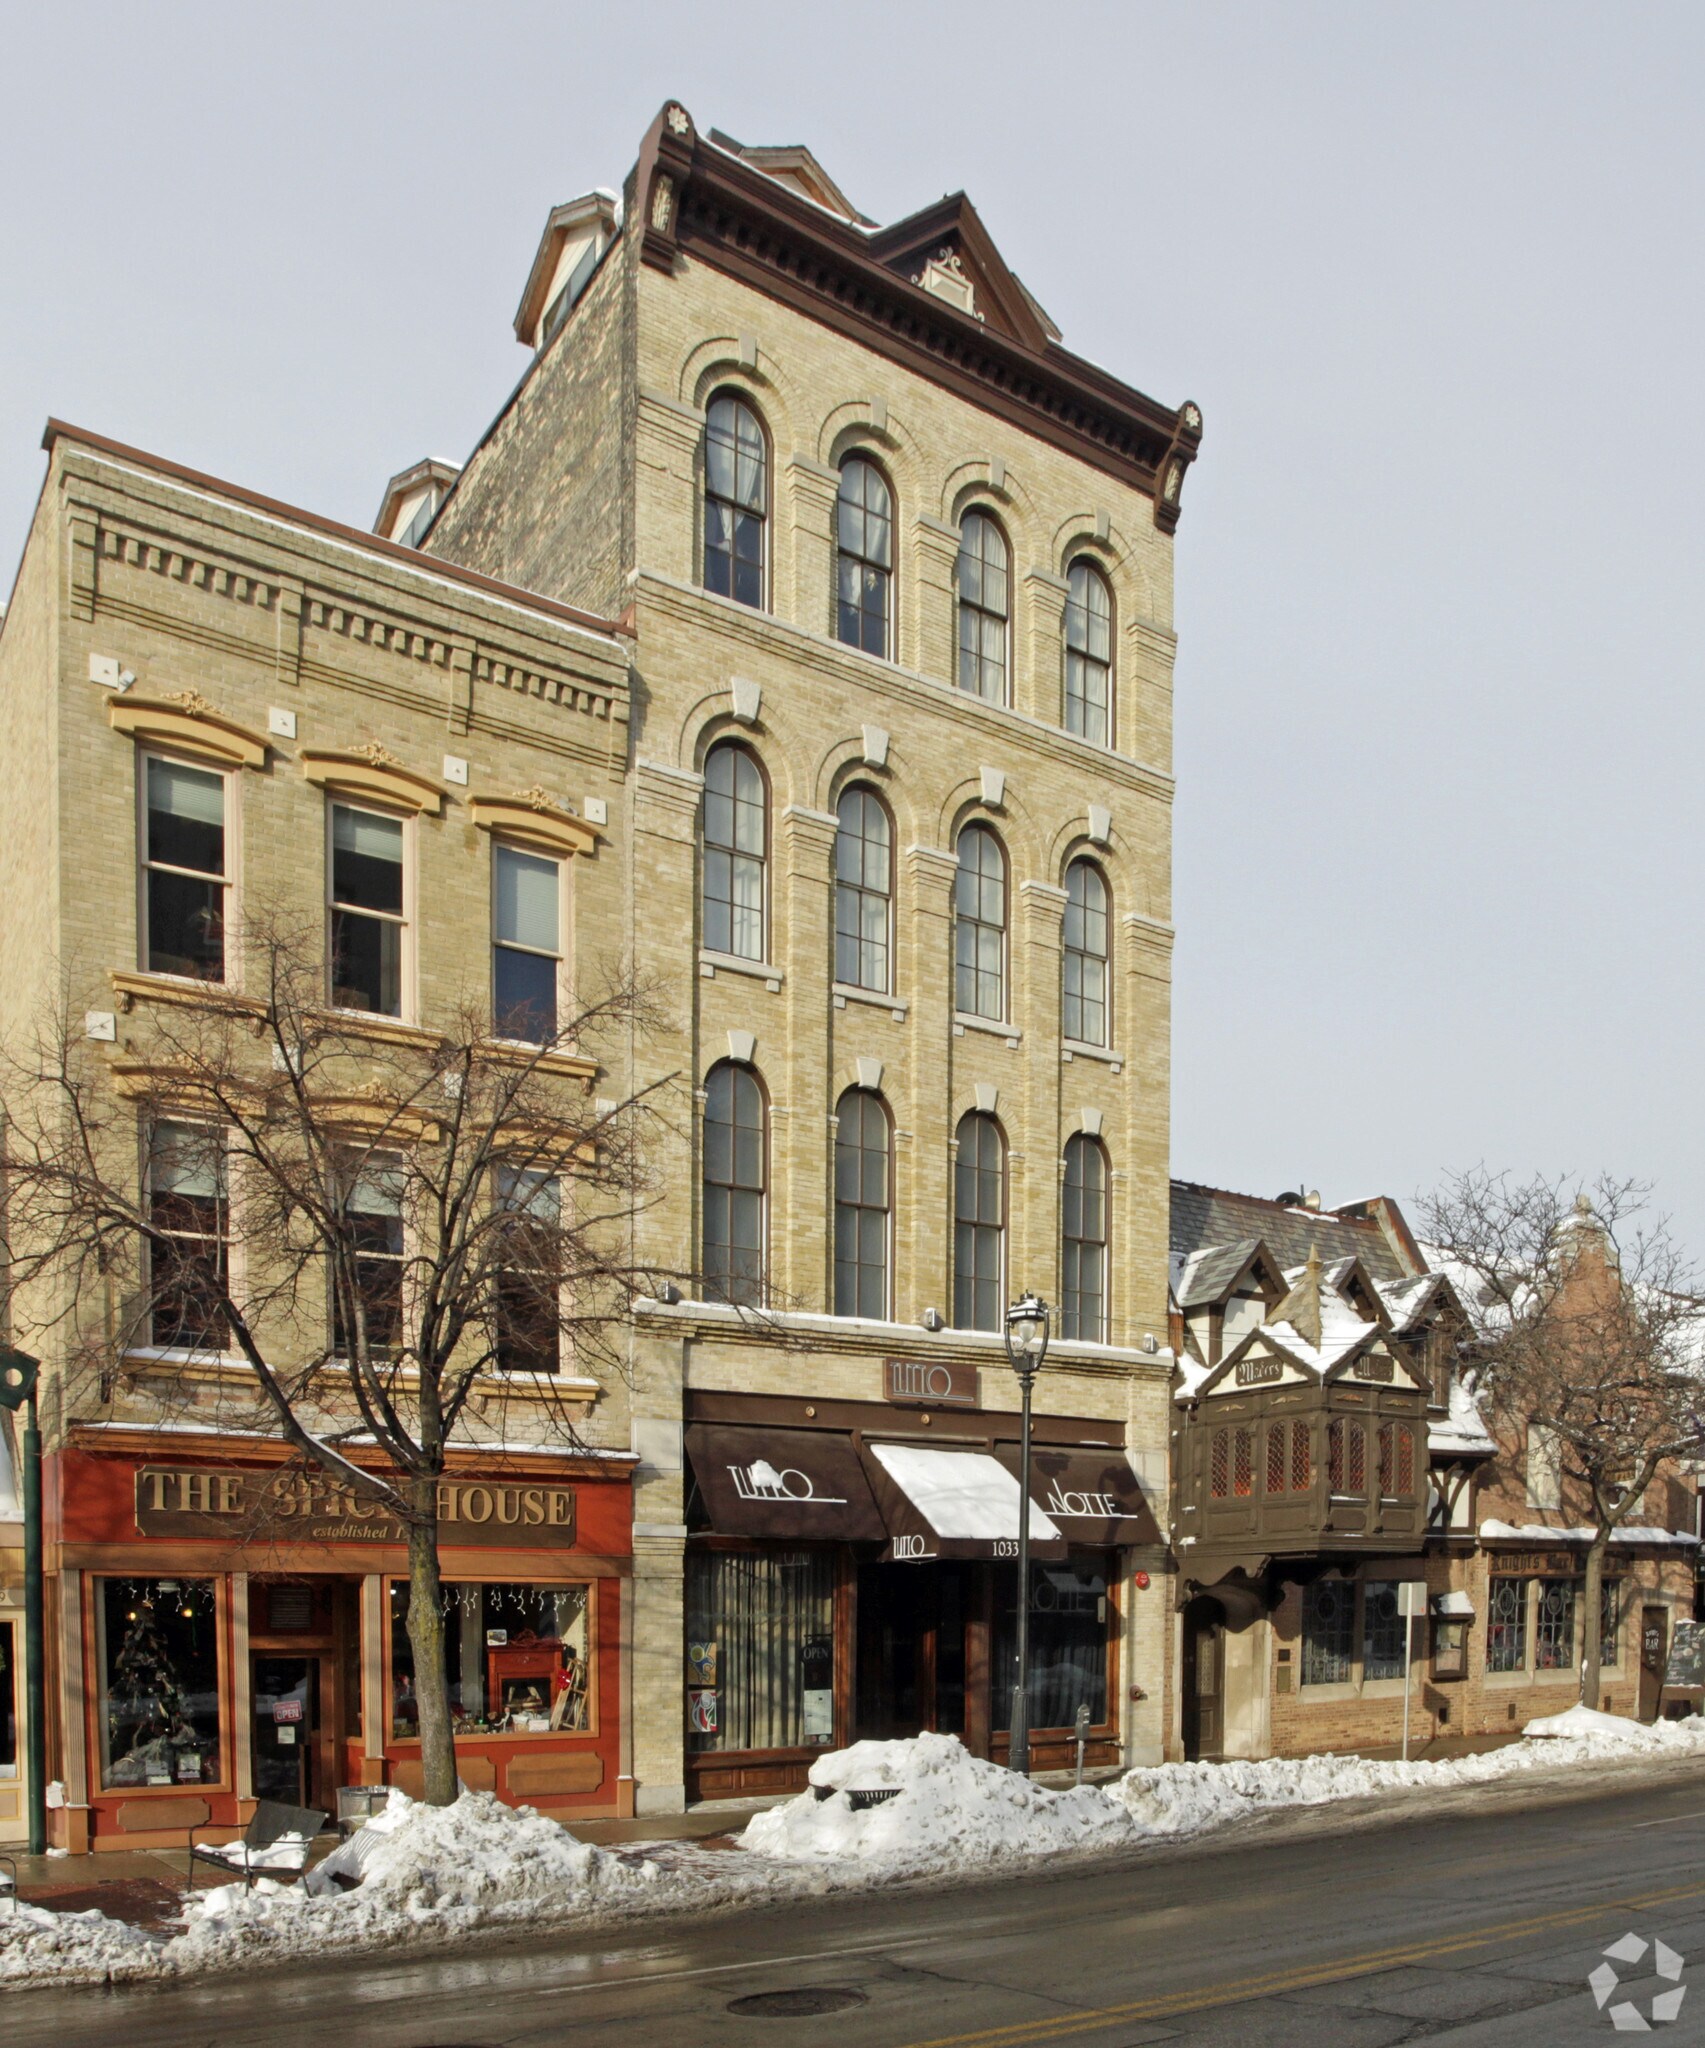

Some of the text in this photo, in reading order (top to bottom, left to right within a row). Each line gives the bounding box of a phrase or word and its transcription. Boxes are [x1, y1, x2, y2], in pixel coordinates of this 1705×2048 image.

[142, 1471, 572, 1527] THE SPIC HOUSE
[1047, 1477, 1122, 1516] NOTTE
[312, 1525, 389, 1539] established
[892, 1534, 926, 1559] TUTTO
[992, 1541, 1020, 1557] 1033
[803, 1646, 829, 1660] OPEN
[276, 1708, 300, 1720] OPEN
